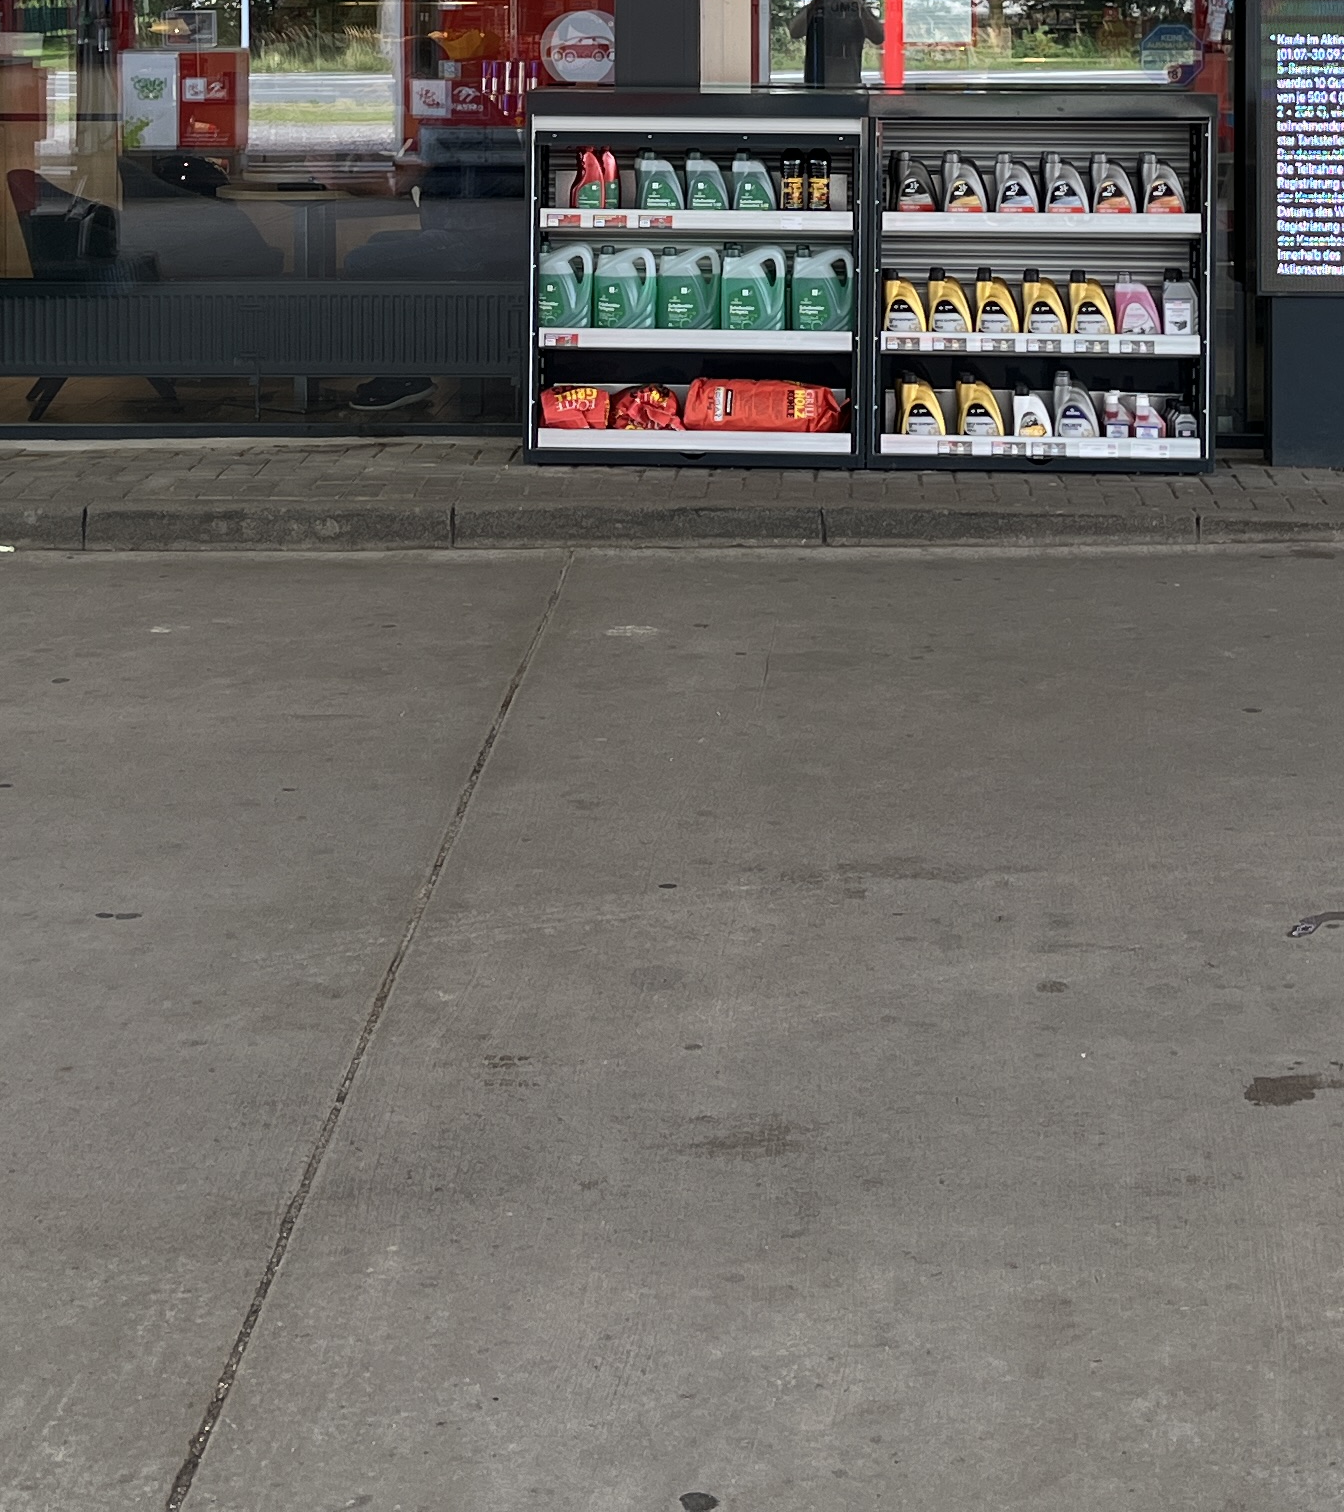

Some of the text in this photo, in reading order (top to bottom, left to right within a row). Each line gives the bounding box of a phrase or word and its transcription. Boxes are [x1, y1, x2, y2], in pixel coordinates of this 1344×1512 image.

[1277, 77, 1313, 89] werden
[1314, 77, 1326, 89] 10
[1277, 91, 1295, 104] von
[1296, 91, 1306, 104] je
[1308, 91, 1328, 104] 500
[1277, 162, 1294, 176] Die
[1295, 162, 1344, 176] Teilnahme
[1277, 177, 1340, 190] Registrierung
[1277, 206, 1314, 219] Datums
[1315, 206, 1333, 219] des
[1277, 220, 1340, 234] Registrierung
[1323, 249, 1341, 261] des
[794, 389, 806, 419] HOLZ
